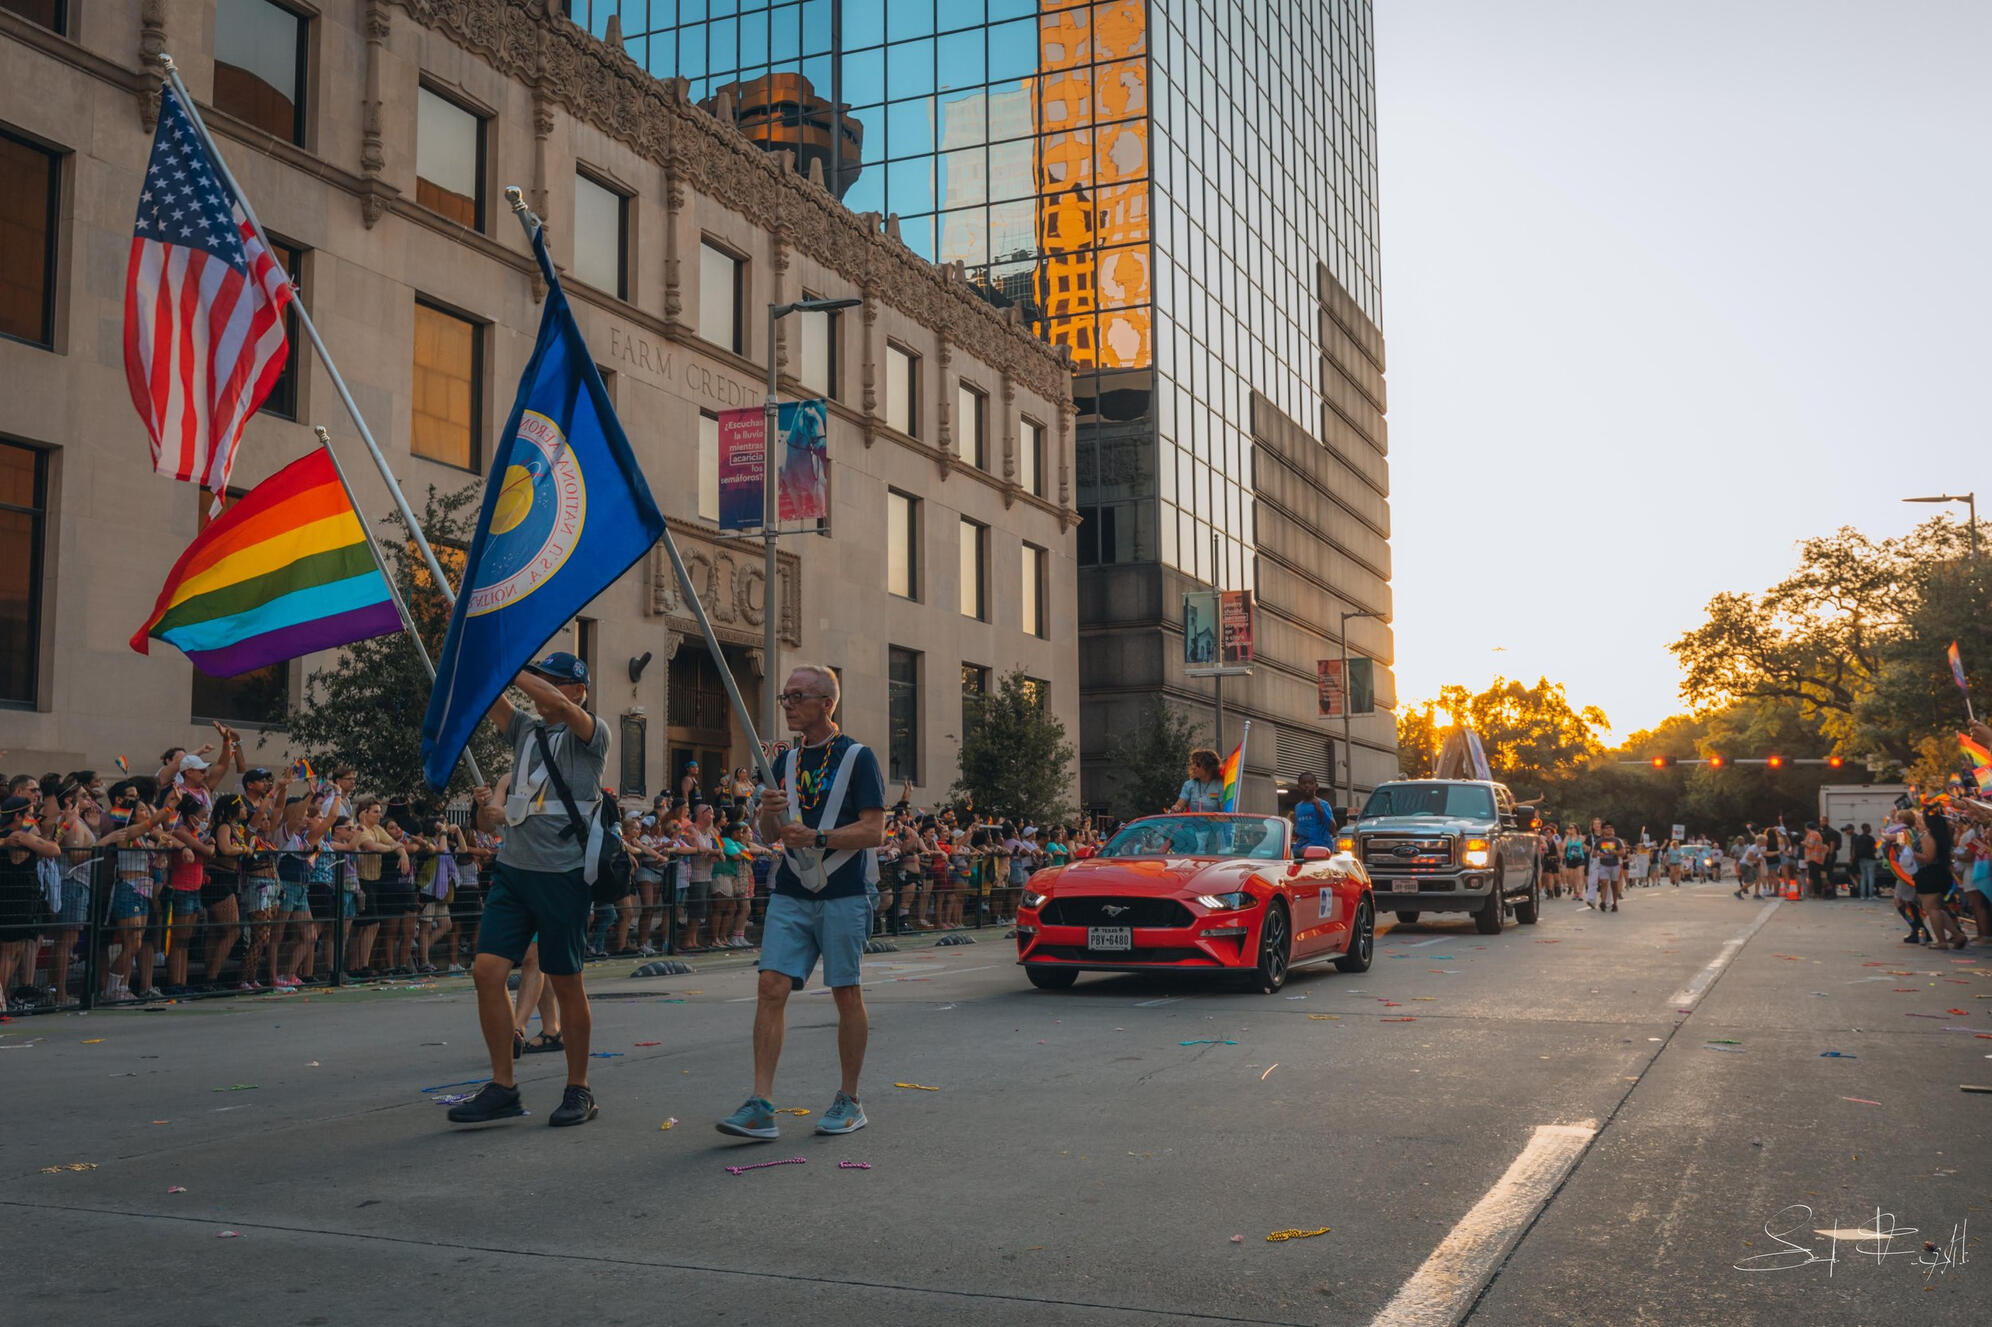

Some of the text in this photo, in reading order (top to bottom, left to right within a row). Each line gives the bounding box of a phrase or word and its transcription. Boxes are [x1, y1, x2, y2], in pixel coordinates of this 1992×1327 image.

[610, 327, 759, 408] FARM CREDIT
[734, 430, 764, 440] la lluvia
[729, 442, 764, 452] mientras
[751, 465, 763, 473] los
[720, 473, 764, 484] semáforos?
